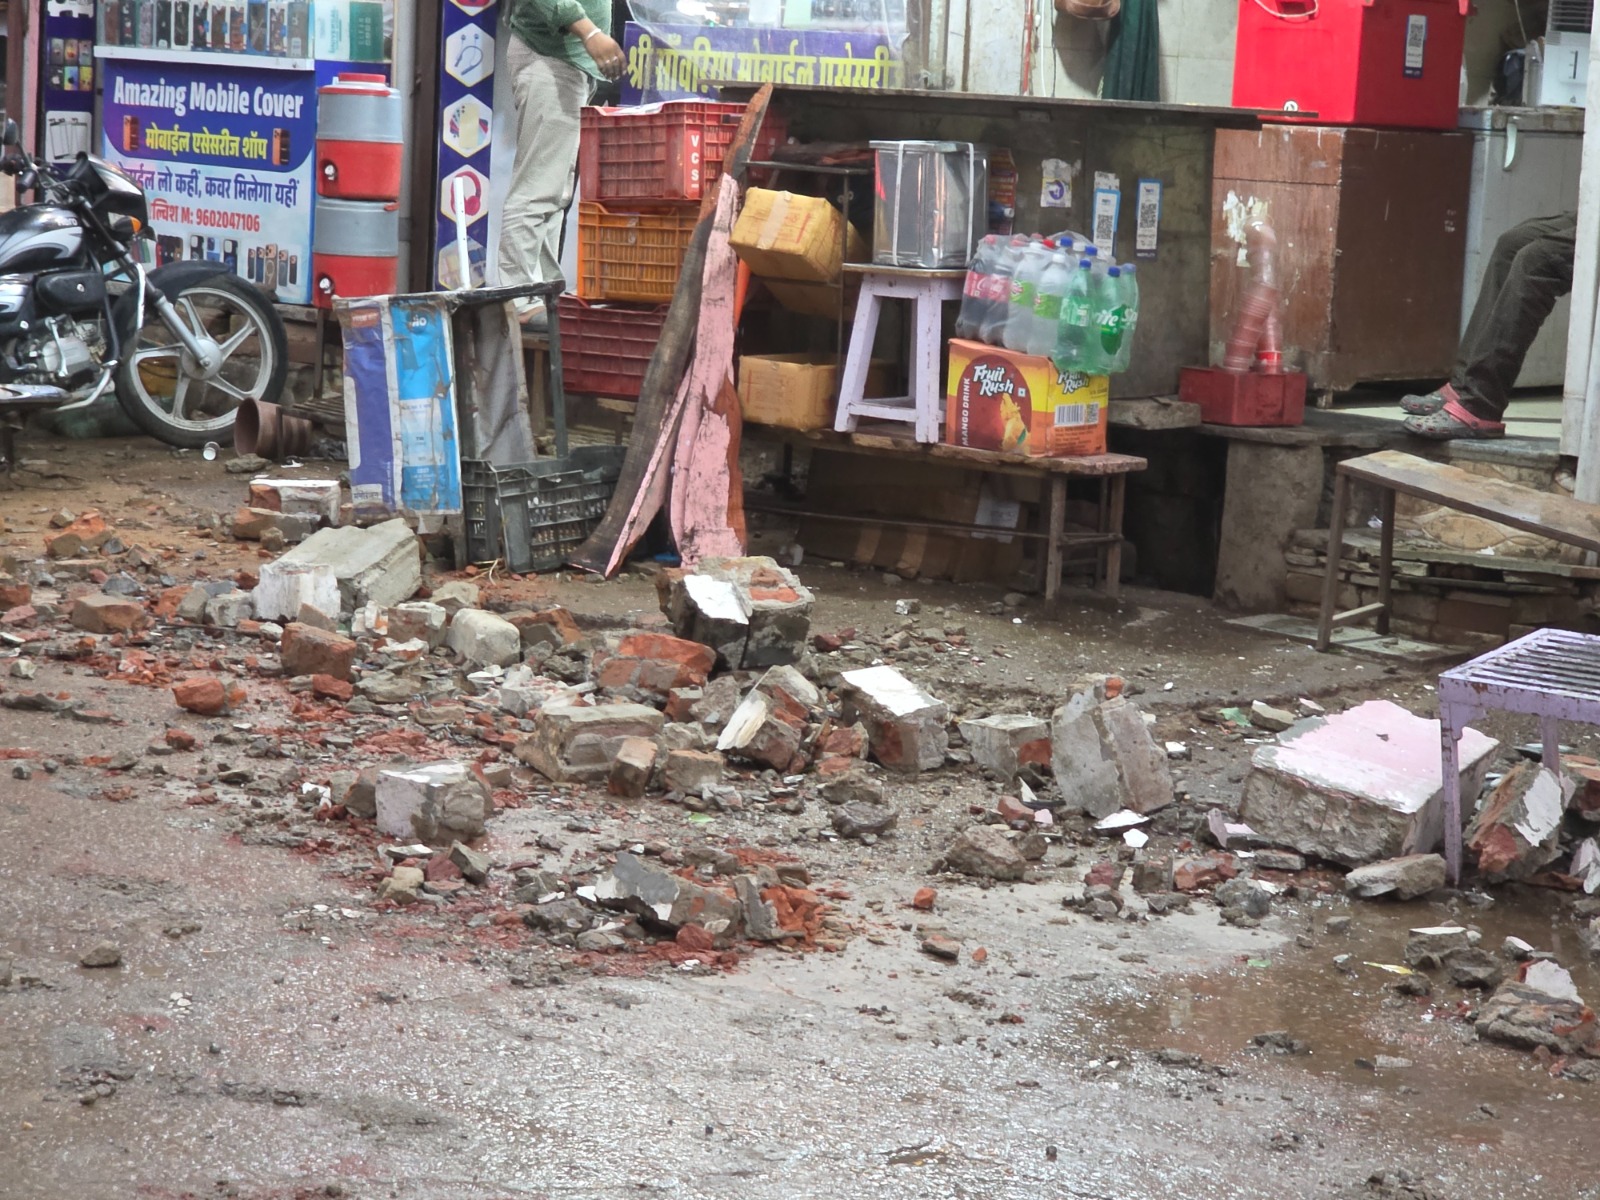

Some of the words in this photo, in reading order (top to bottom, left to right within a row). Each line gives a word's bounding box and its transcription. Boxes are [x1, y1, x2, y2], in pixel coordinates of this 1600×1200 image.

[113, 76, 187, 117] Amazing
[189, 81, 250, 115] Mobile
[253, 86, 304, 119] Cover
[145, 121, 190, 156] मोबाईल
[192, 127, 240, 157] एसेसरीज
[242, 130, 268, 160] शॉप
[157, 166, 173, 193] लो
[205, 176, 231, 199] कवर
[234, 173, 272, 203] मिलेगा
[275, 179, 300, 208] यहीं
[149, 198, 179, 223] ल्विश
[181, 206, 194, 225] M:
[196, 208, 261, 232] 9602047106
[973, 364, 1005, 382] Fruit
[979, 379, 1014, 397] Rush
[962, 377, 970, 408] DRINK
[961, 409, 969, 447] MANGO
